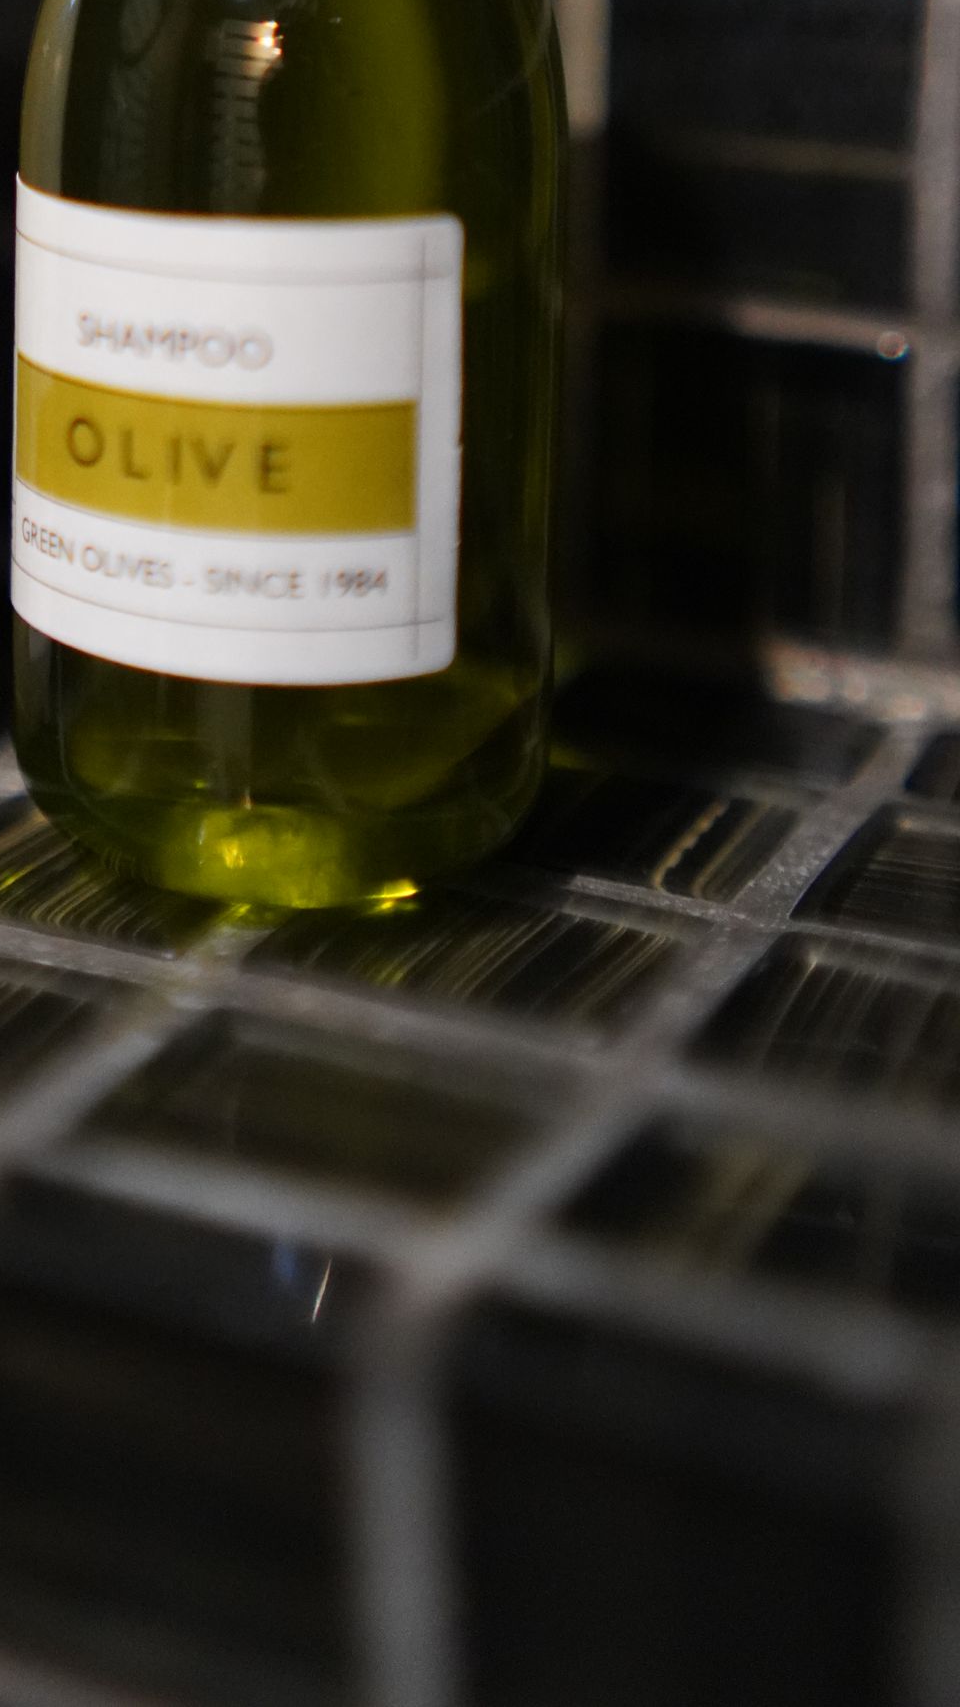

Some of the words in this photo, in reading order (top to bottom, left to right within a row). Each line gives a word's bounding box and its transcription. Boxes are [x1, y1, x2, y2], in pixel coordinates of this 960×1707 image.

[76, 311, 275, 370] SHAMPOO
[66, 417, 291, 494] OLIVE
[21, 517, 75, 565] GREEN
[82, 545, 174, 589] OLIVES
[203, 565, 306, 600] SINCE
[320, 568, 389, 598] 1984
